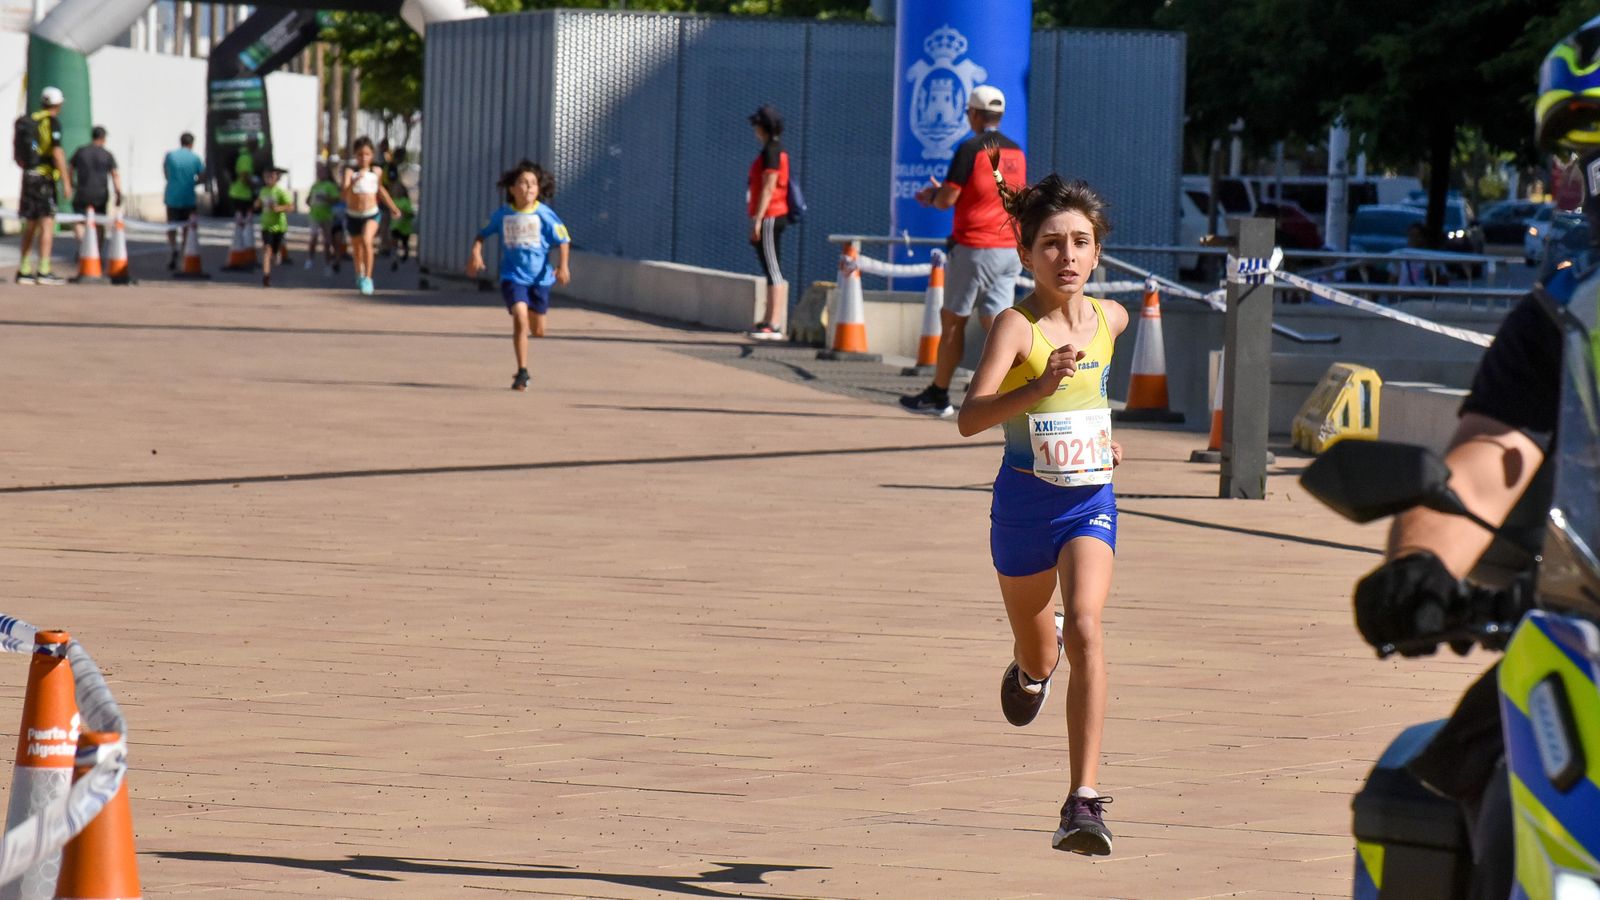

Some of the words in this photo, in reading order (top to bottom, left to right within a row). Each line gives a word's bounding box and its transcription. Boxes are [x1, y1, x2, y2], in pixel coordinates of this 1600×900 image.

[1034, 420, 1053, 432] XXI
[1039, 437, 1096, 467] 1021
[28, 726, 67, 741] Puerto
